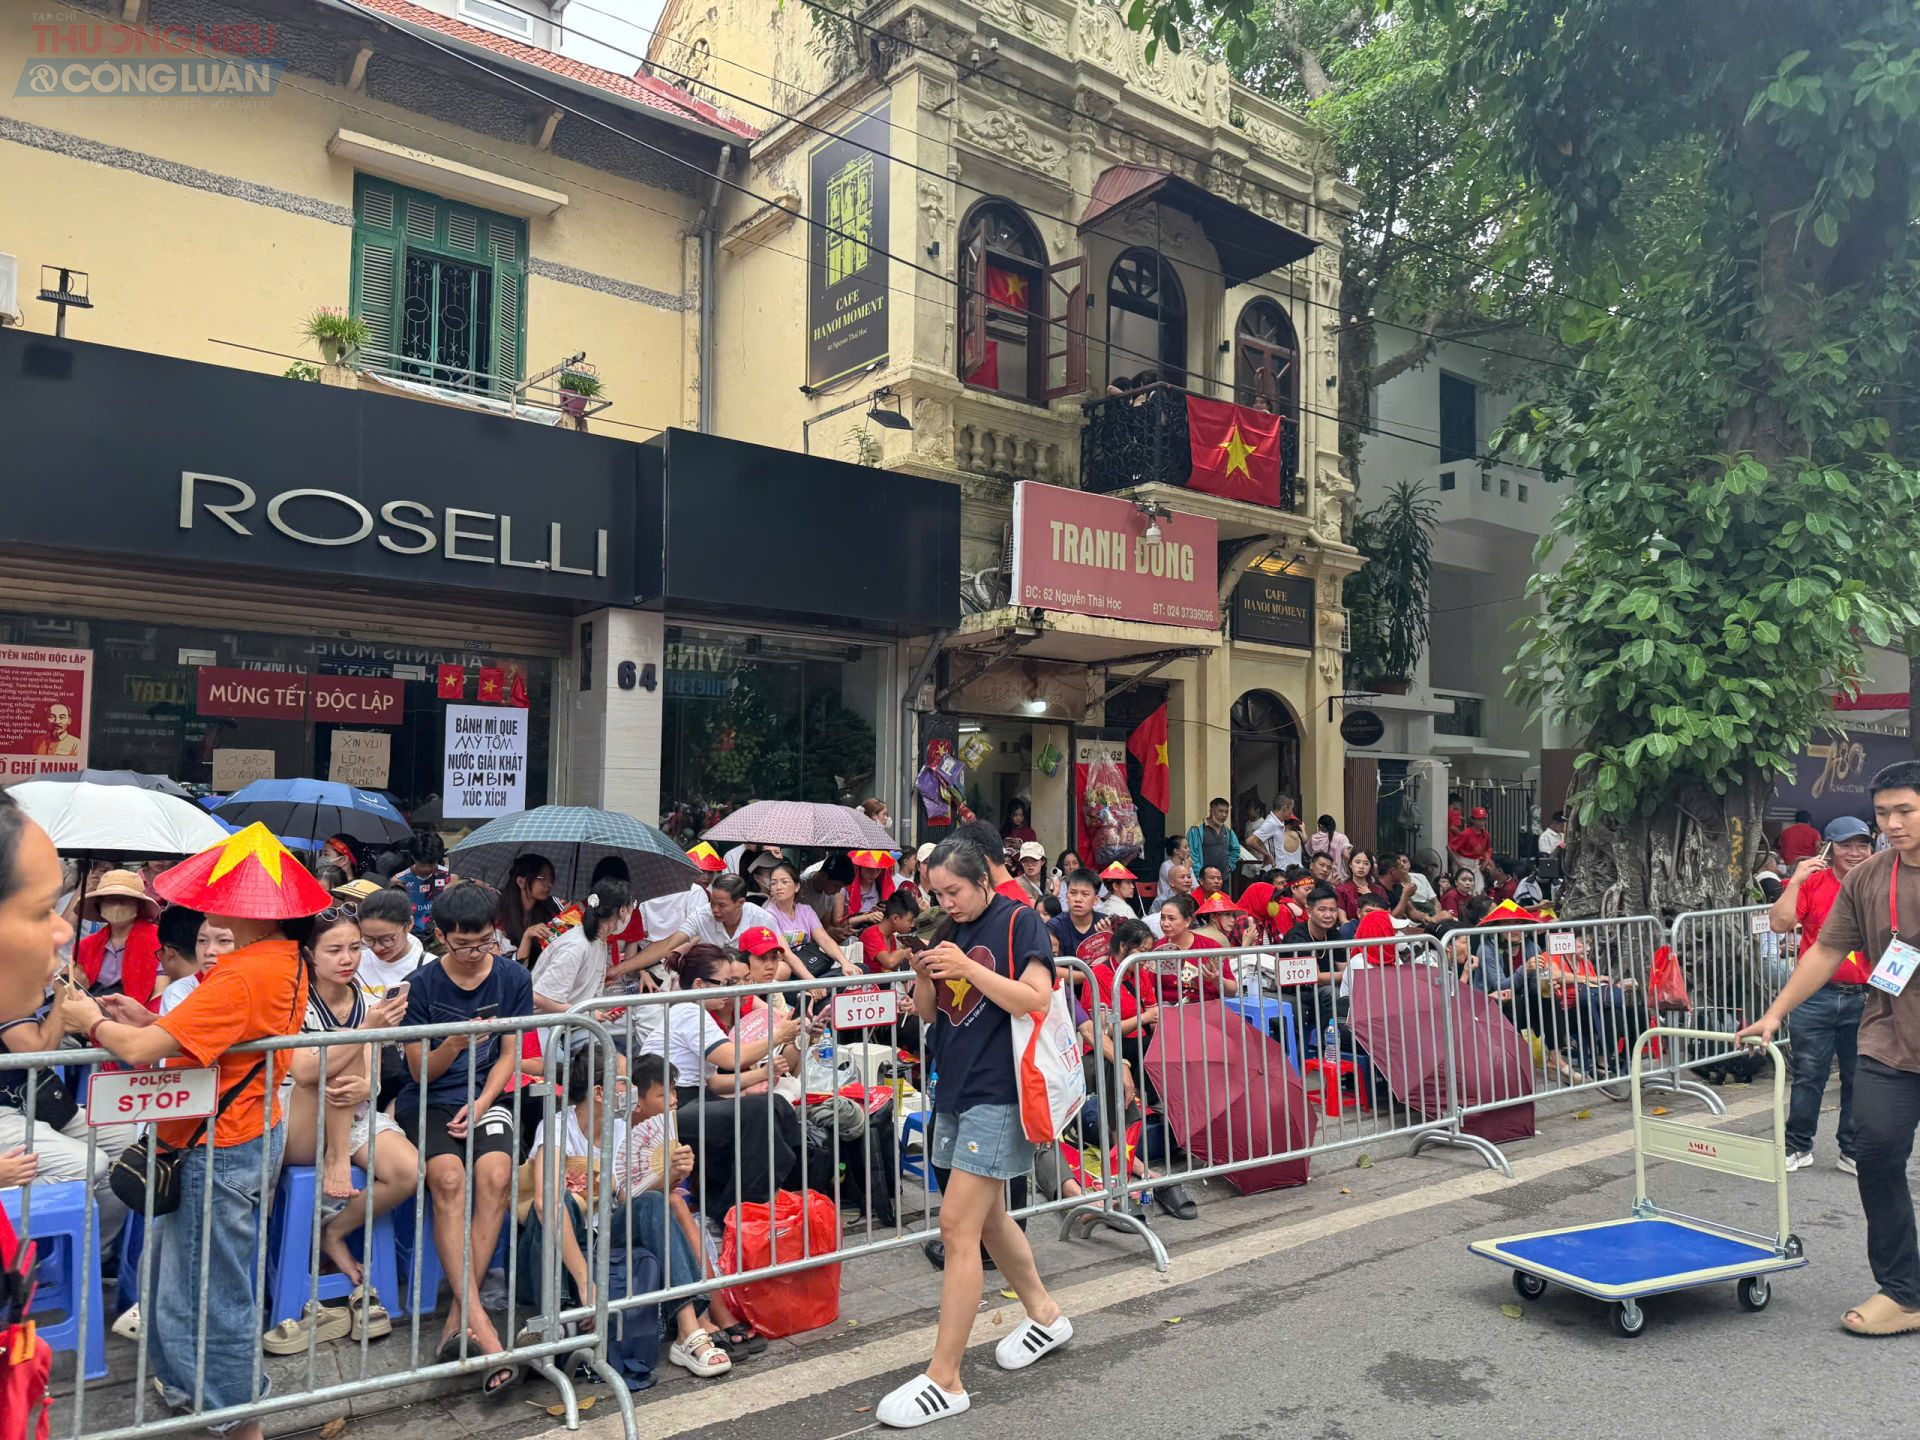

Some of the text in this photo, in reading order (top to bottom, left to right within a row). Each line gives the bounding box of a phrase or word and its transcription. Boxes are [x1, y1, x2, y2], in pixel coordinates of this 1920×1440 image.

[836, 289, 860, 311] CAFE
[814, 296, 884, 341] HANOI MOMENT
[180, 471, 607, 577] ROSELLI
[1050, 520, 1126, 572] TRANH
[1025, 585, 1122, 611] ĐC: 62 Nguyễn Thái Học
[1266, 588, 1287, 602] CAFE
[1153, 602, 1165, 615] ĐT:
[1167, 605, 1180, 617] 024
[1244, 598, 1307, 618] HANOI MOMENT
[21, 651, 46, 661] NGÔN
[49, 653, 67, 664] ĐỘC
[69, 653, 86, 665] LẬP
[617, 660, 657, 692] 64
[209, 682, 394, 713] MỪNG TẾT ĐỘC LẬP
[456, 714, 518, 736] BÁNH MÌ QUE
[485, 734, 513, 750] TÔM
[448, 750, 523, 771] NƯỚC GIẢI KHÁT
[1110, 750, 1123, 761] 62
[11, 758, 37, 774] CHÍ
[41, 762, 79, 774] MINH
[462, 788, 507, 806] XÚC XÍCH
[1555, 942, 1571, 951] STOP
[1287, 968, 1310, 980] STOP
[1886, 960, 1904, 977] N
[852, 994, 880, 1003] POLICE
[847, 1006, 886, 1021] STOP
[130, 1072, 181, 1087] POLICE
[118, 1091, 190, 1113] STOP
